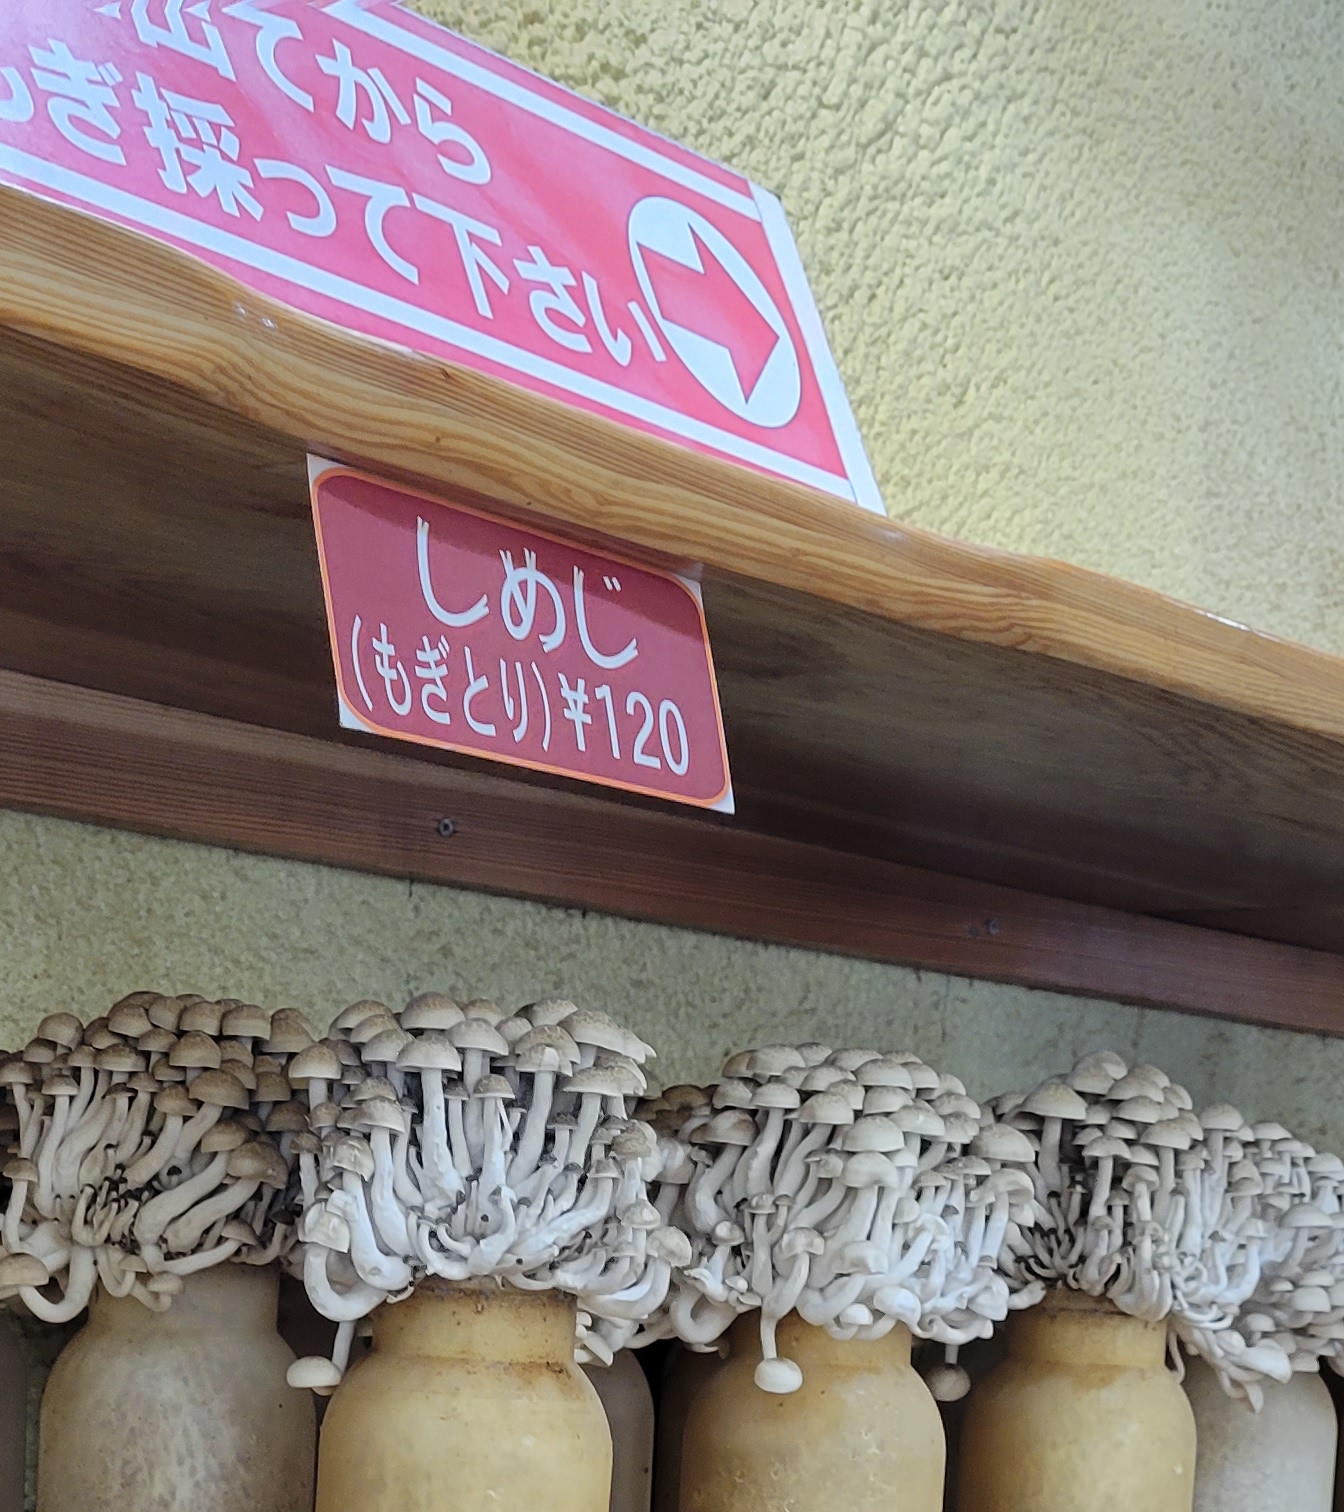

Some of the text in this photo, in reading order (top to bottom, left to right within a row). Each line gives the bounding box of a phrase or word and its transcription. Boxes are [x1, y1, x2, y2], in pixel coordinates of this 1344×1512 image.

[93, 0, 493, 185] 出てから
[416, 515, 640, 669] しめじ
